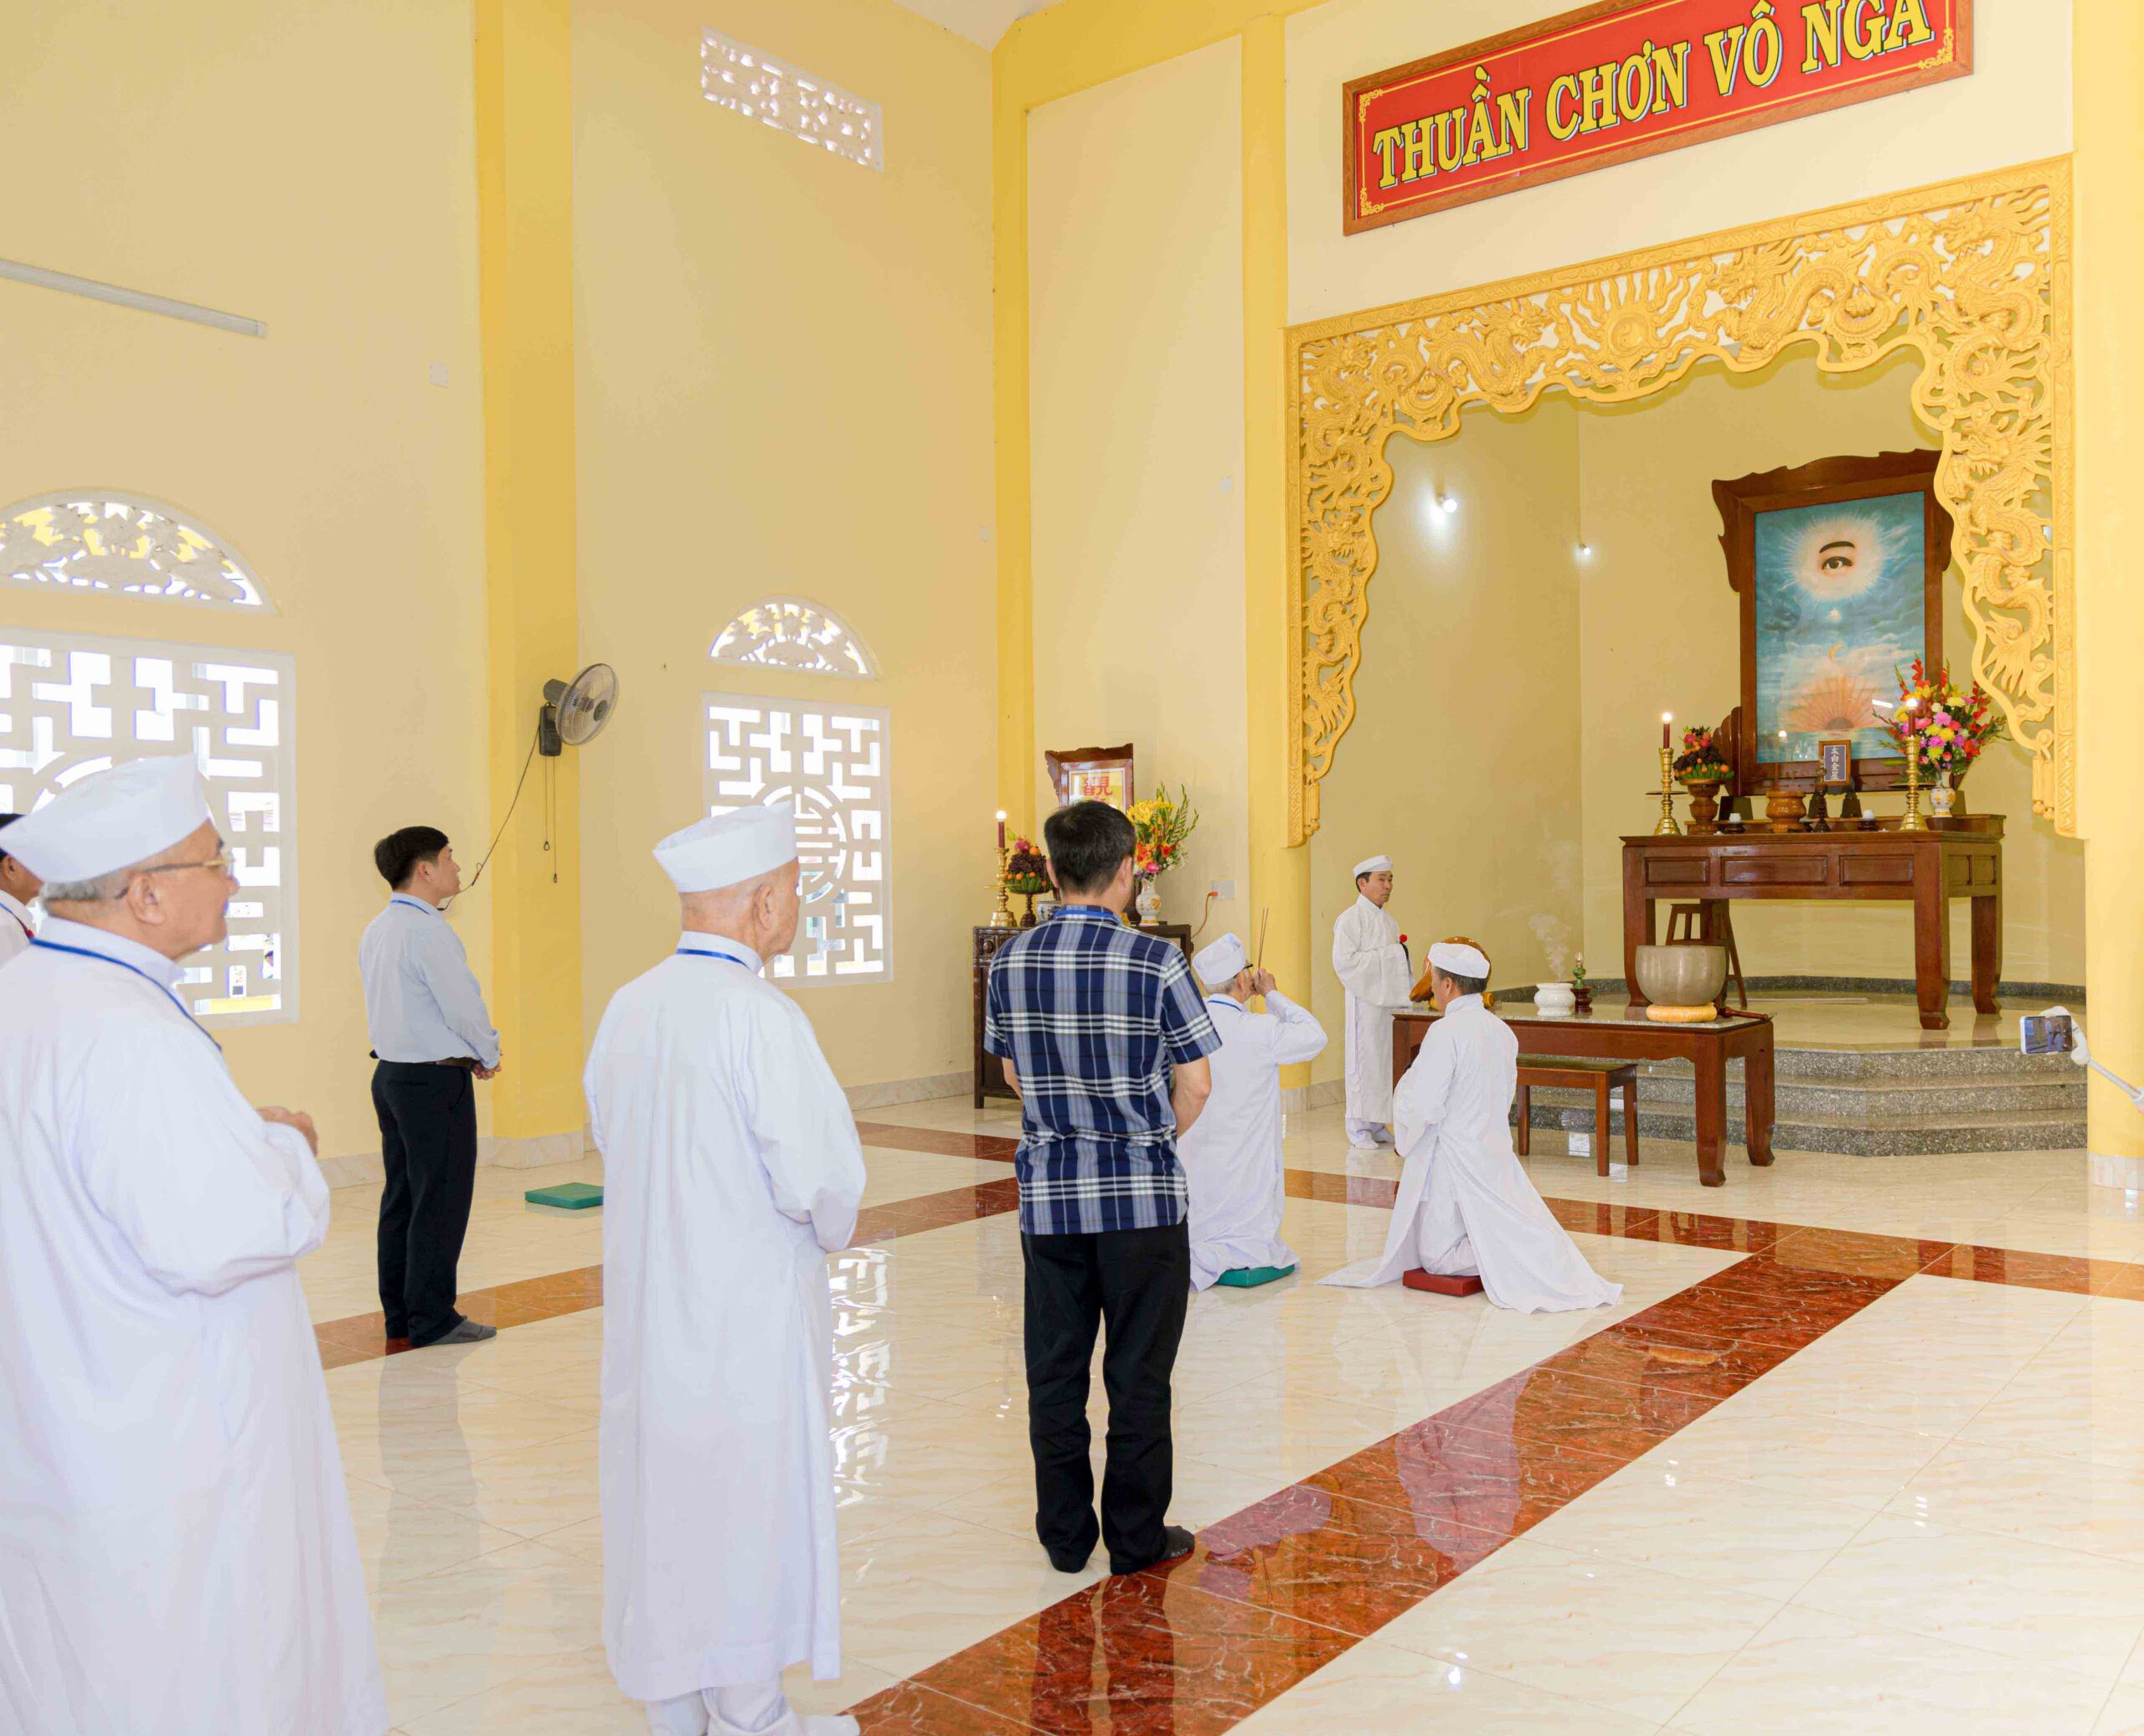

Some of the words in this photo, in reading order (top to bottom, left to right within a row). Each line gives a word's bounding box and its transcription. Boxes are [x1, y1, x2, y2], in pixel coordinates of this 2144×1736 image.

[1372, 64, 1531, 189] THUẦN
[1545, 39, 1690, 142] CHƠN
[1703, 0, 1781, 95] VÔ
